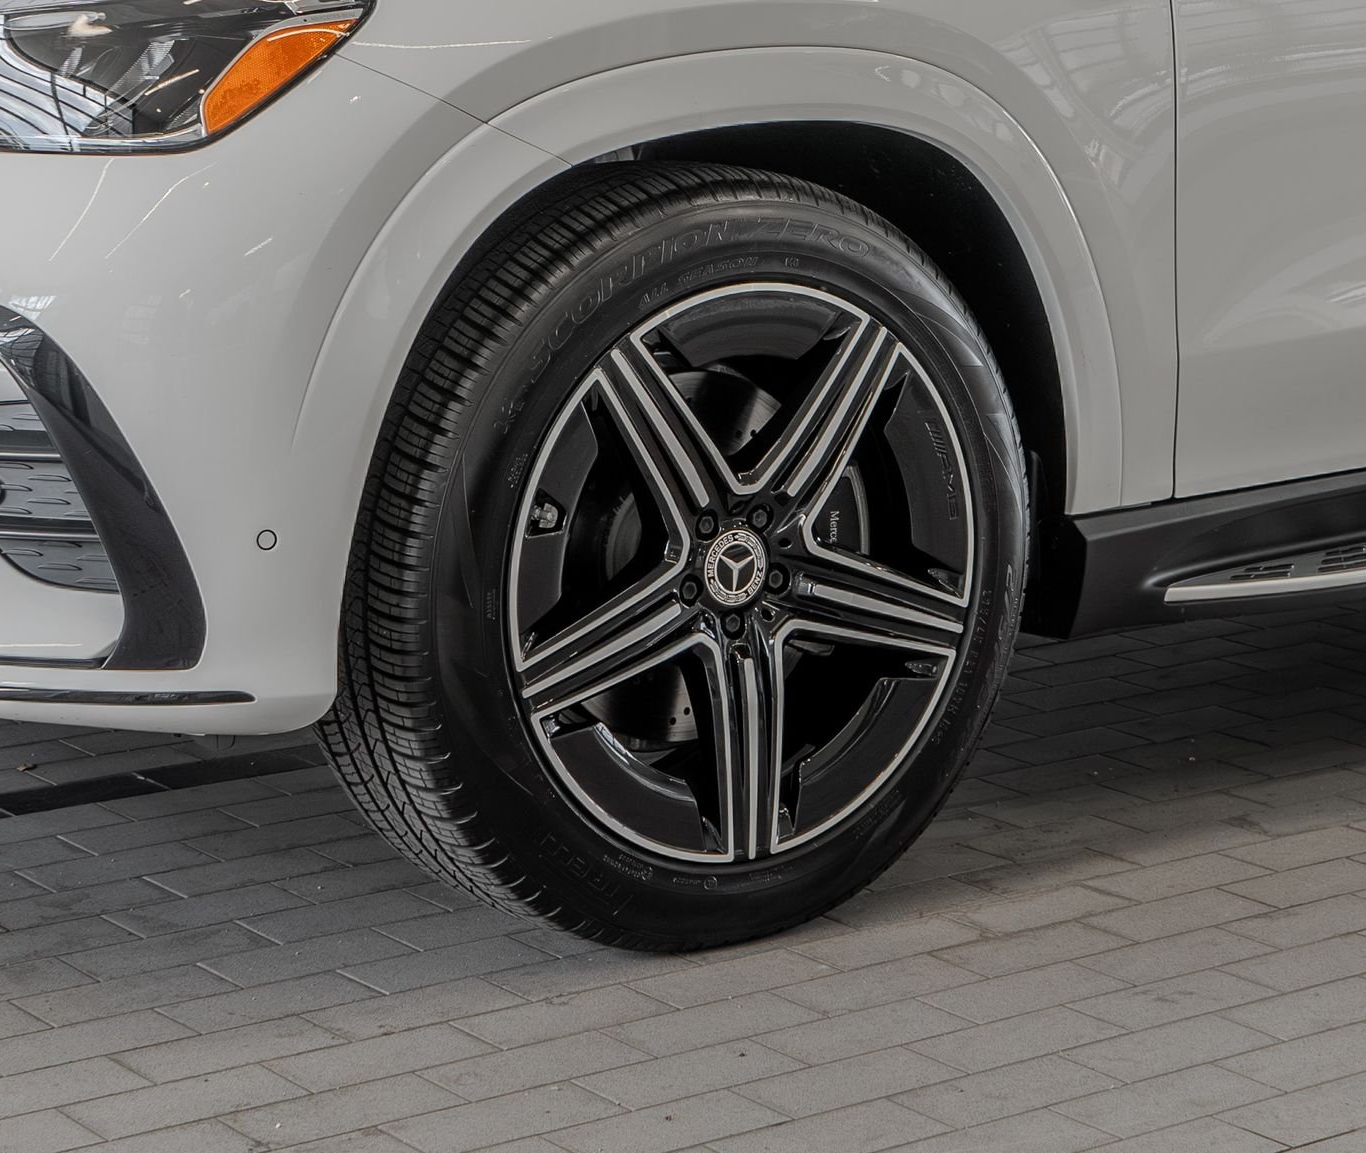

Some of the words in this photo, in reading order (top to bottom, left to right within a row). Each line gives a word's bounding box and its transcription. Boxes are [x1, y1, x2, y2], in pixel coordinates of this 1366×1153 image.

[530, 218, 730, 384] SCORPION
[747, 217, 870, 258] ZERO
[707, 533, 735, 578] MERCEDES
[747, 570, 764, 595] BENZ
